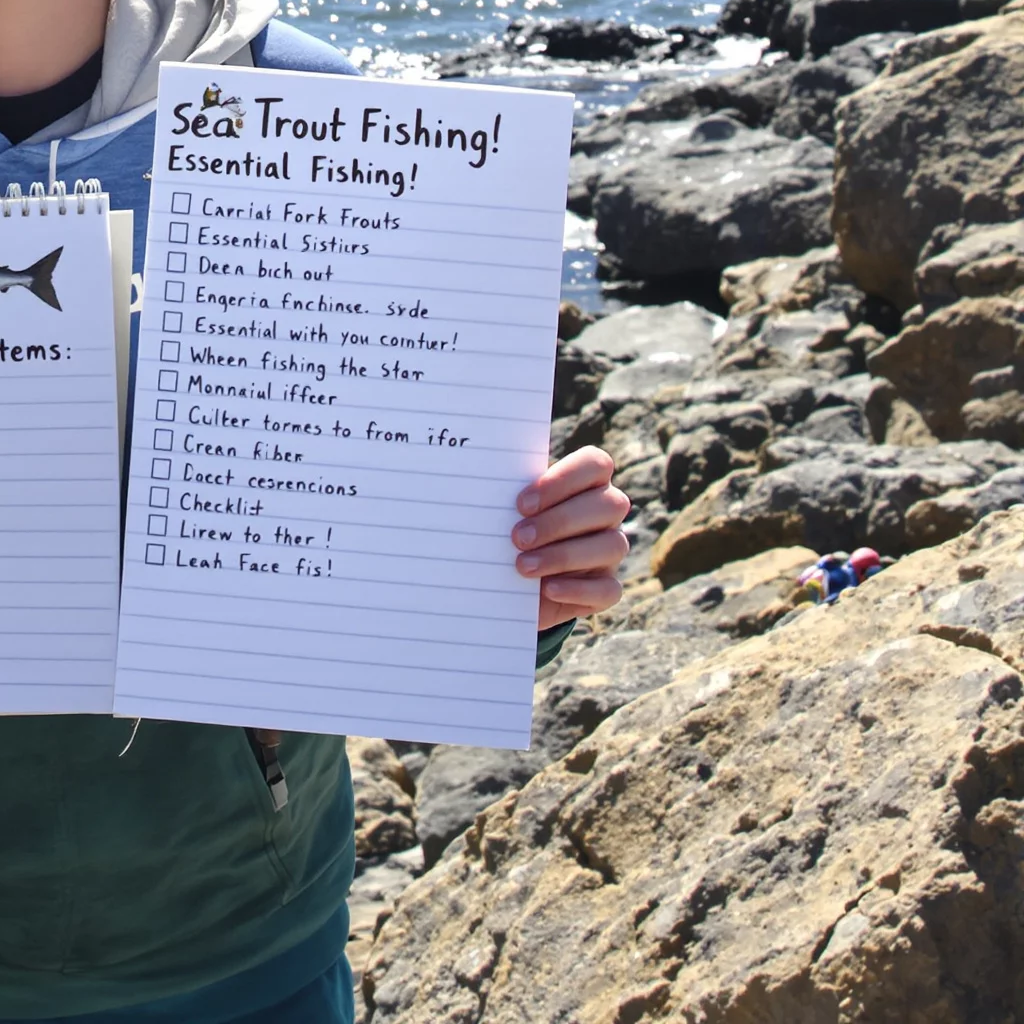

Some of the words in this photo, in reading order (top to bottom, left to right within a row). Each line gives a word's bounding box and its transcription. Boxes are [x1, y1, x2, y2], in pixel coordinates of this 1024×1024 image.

[171, 102, 240, 139] Sea
[254, 97, 346, 142] Trout
[361, 108, 501, 168] Fishing!
[168, 145, 290, 180] Essential
[312, 155, 418, 197] Fishing!
[283, 203, 328, 225] Fork
[341, 208, 400, 230] Frouts
[198, 227, 287, 250] Essential
[304, 265, 334, 281] out
[195, 317, 276, 339] Essential
[289, 324, 328, 343] with
[341, 330, 369, 347] you
[261, 352, 326, 381] fishing
[340, 357, 367, 377] the
[332, 420, 351, 438] to
[366, 424, 409, 443] from
[244, 527, 261, 543] to
[240, 554, 279, 573] Face
[296, 558, 332, 577] fis!
